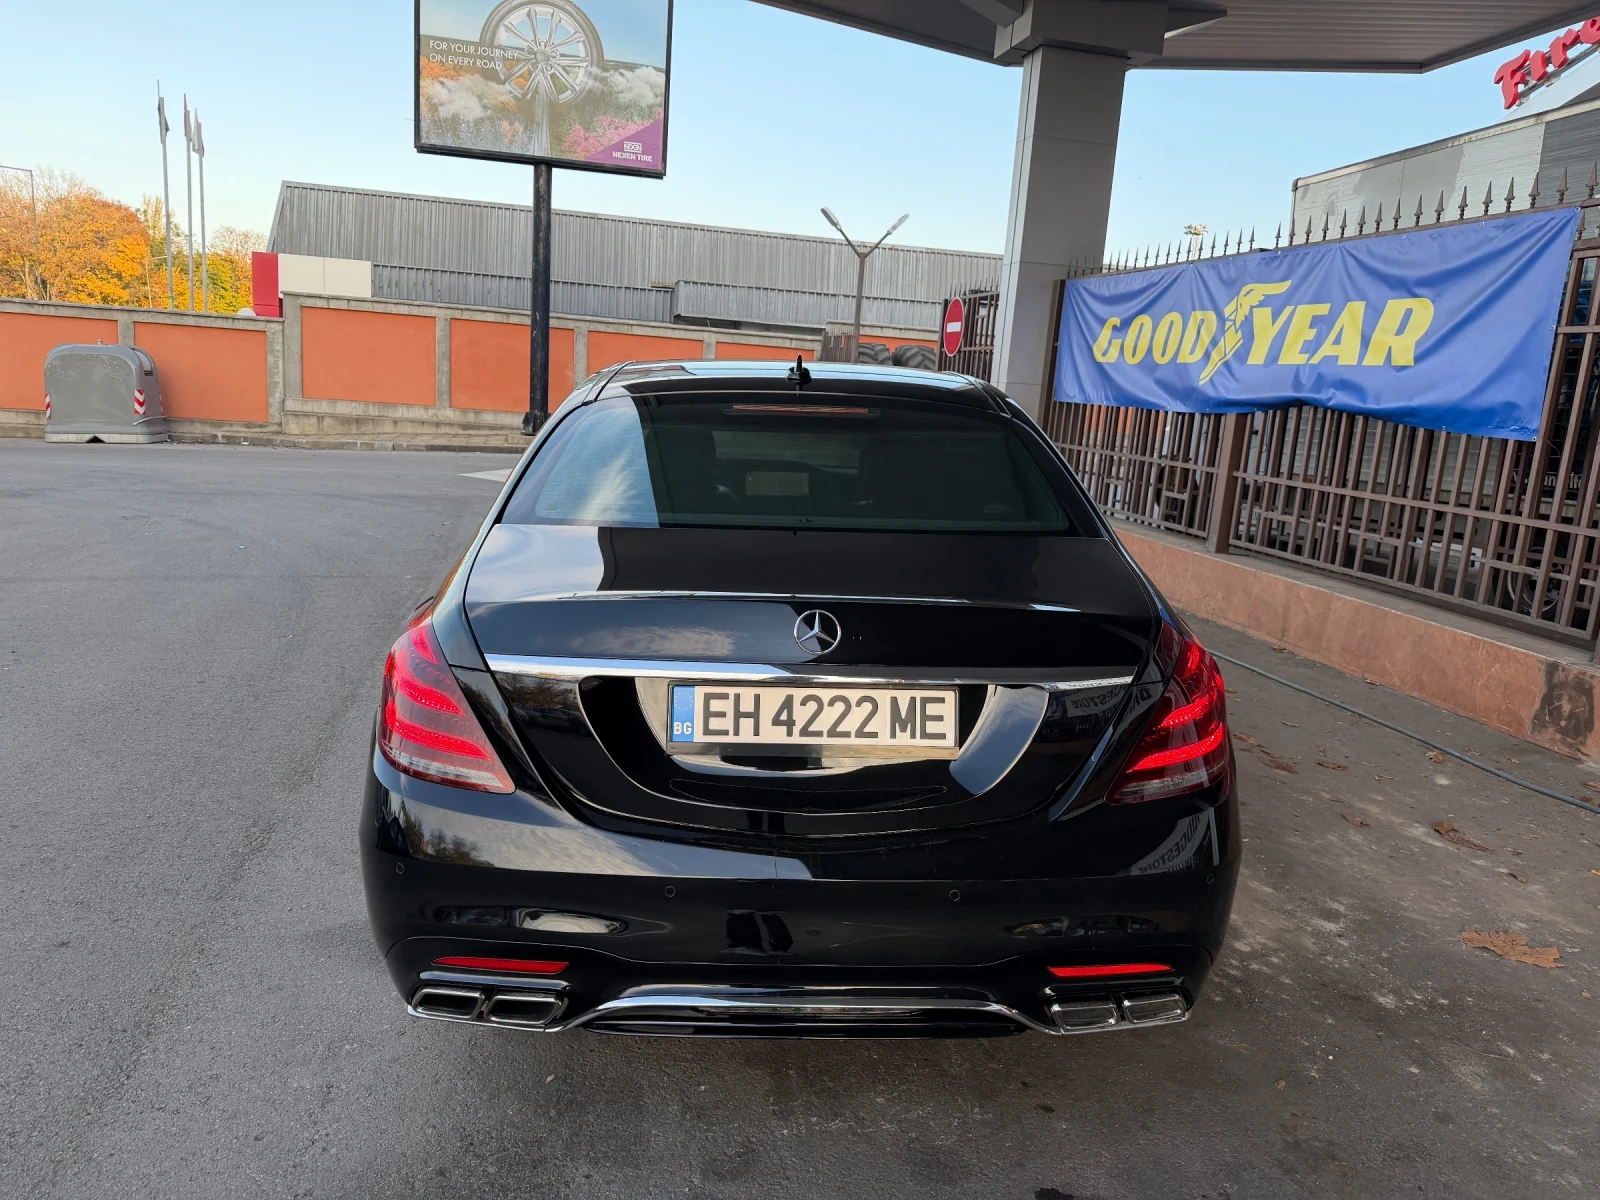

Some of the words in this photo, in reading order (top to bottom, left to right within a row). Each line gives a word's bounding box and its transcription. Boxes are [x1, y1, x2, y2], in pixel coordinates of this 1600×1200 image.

[429, 40, 448, 51] FOR
[450, 43, 475, 54] YOUR
[476, 46, 519, 60] JOURNEY
[429, 53, 446, 63] ON
[448, 55, 475, 67] EVERY
[476, 59, 502, 70] ROAD
[612, 151, 636, 160] NEXEN
[637, 154, 653, 162] TIRE
[702, 692, 760, 737] EH
[771, 694, 879, 739] 4222
[889, 696, 947, 741] ME
[673, 722, 692, 735] BG
